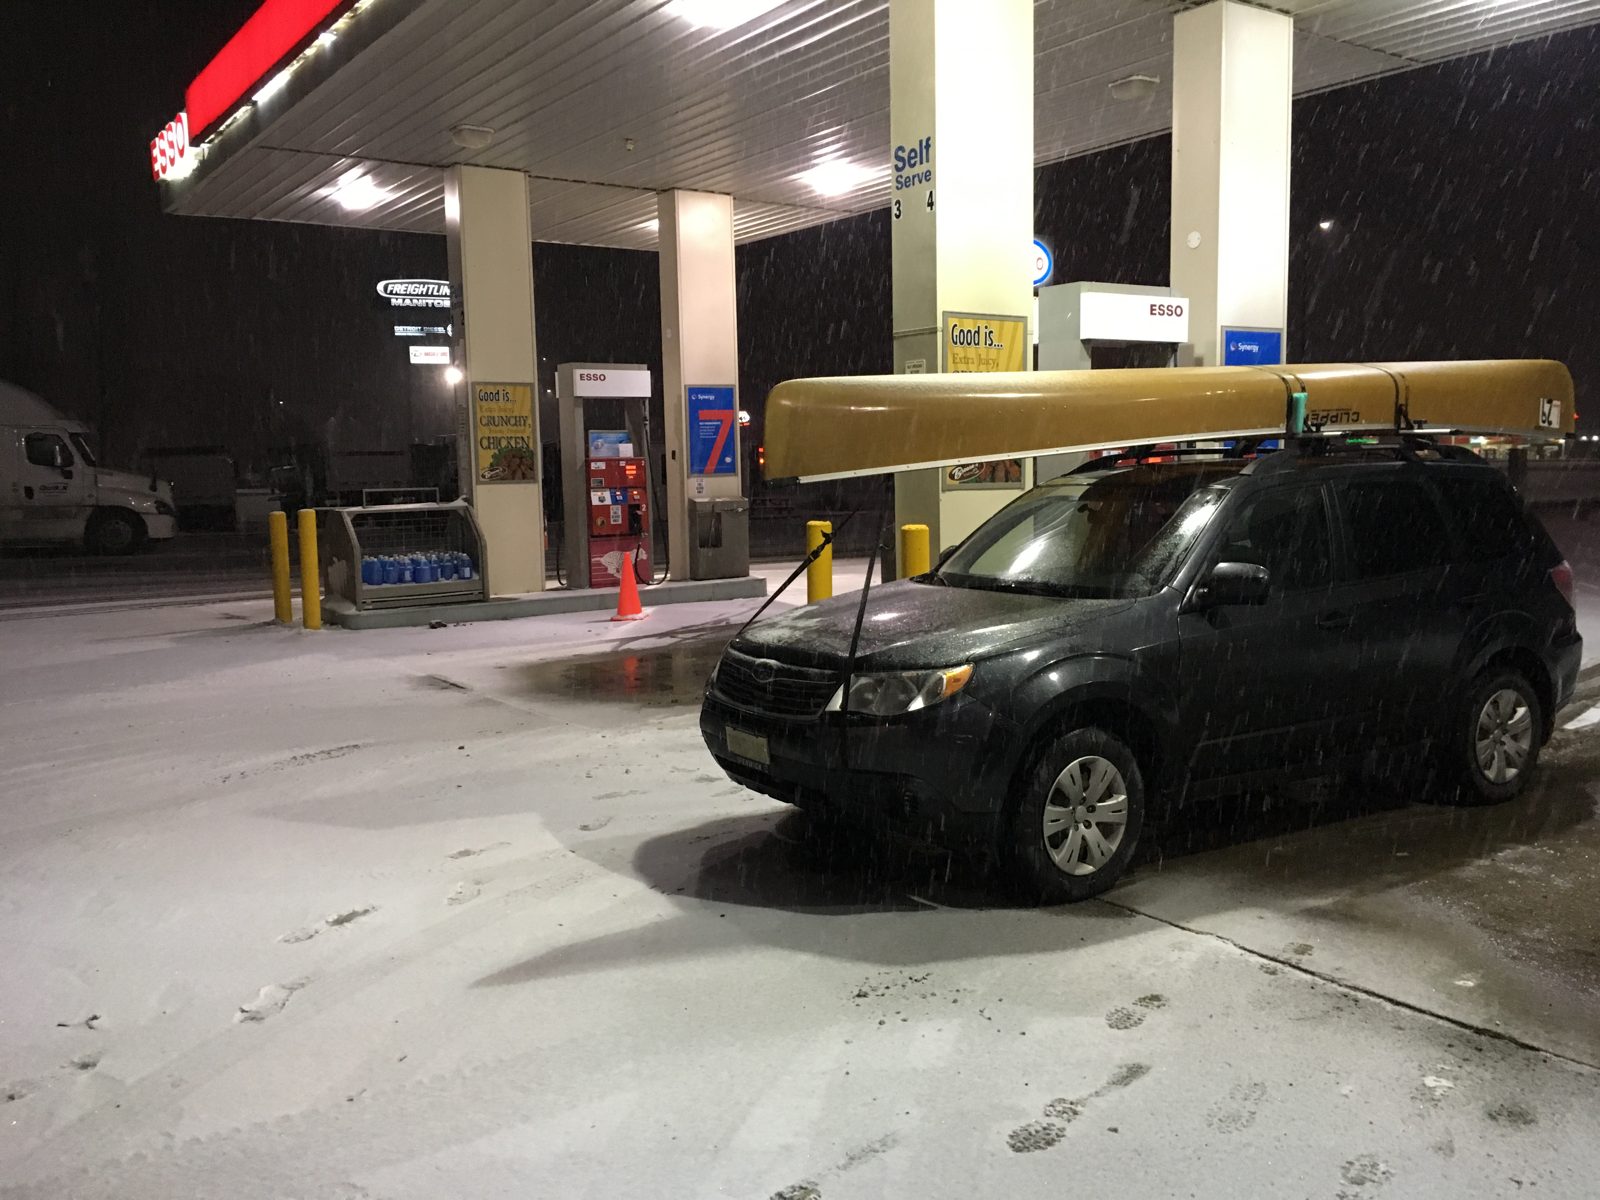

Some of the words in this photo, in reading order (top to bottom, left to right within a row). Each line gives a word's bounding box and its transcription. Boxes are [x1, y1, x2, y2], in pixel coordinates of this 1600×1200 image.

[150, 113, 185, 182] ESSO
[894, 136, 931, 172] Self
[895, 169, 931, 190] Serve
[894, 199, 901, 219] 3
[926, 190, 934, 211] 4
[1150, 303, 1183, 317] ESSO
[951, 323, 980, 346] Good
[984, 325, 1003, 348] is...
[1238, 342, 1259, 352] Synergy
[952, 353, 975, 365] Extra
[579, 373, 606, 382] ESSO
[478, 388, 500, 402] Good
[480, 415, 531, 428] CRUNCHY,
[1304, 411, 1360, 424] CLIPPE
[480, 435, 530, 450] CHICKEN
[698, 410, 734, 474] 7
